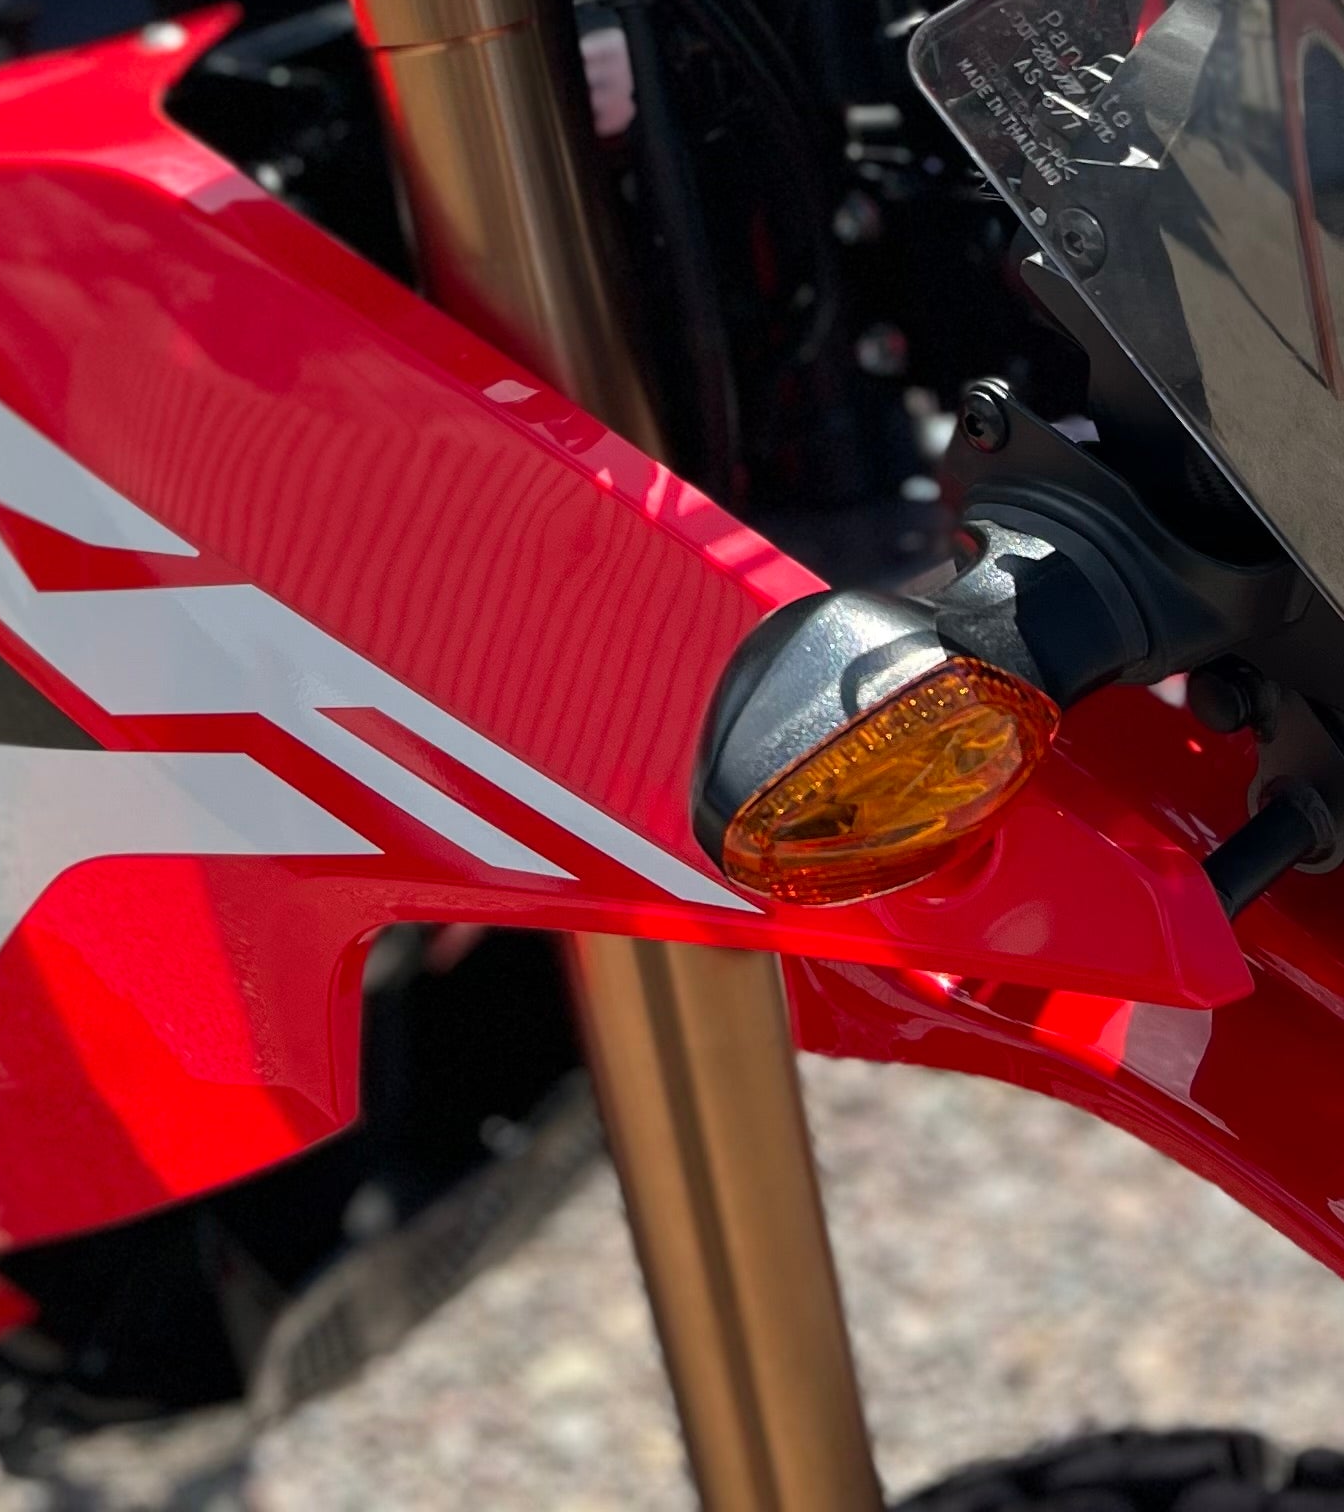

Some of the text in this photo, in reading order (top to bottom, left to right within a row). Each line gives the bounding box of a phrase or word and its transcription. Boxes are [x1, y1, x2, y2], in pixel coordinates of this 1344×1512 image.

[957, 57, 993, 97] MADE
[987, 96, 1006, 117] IN
[998, 110, 1062, 186] THAILAND
